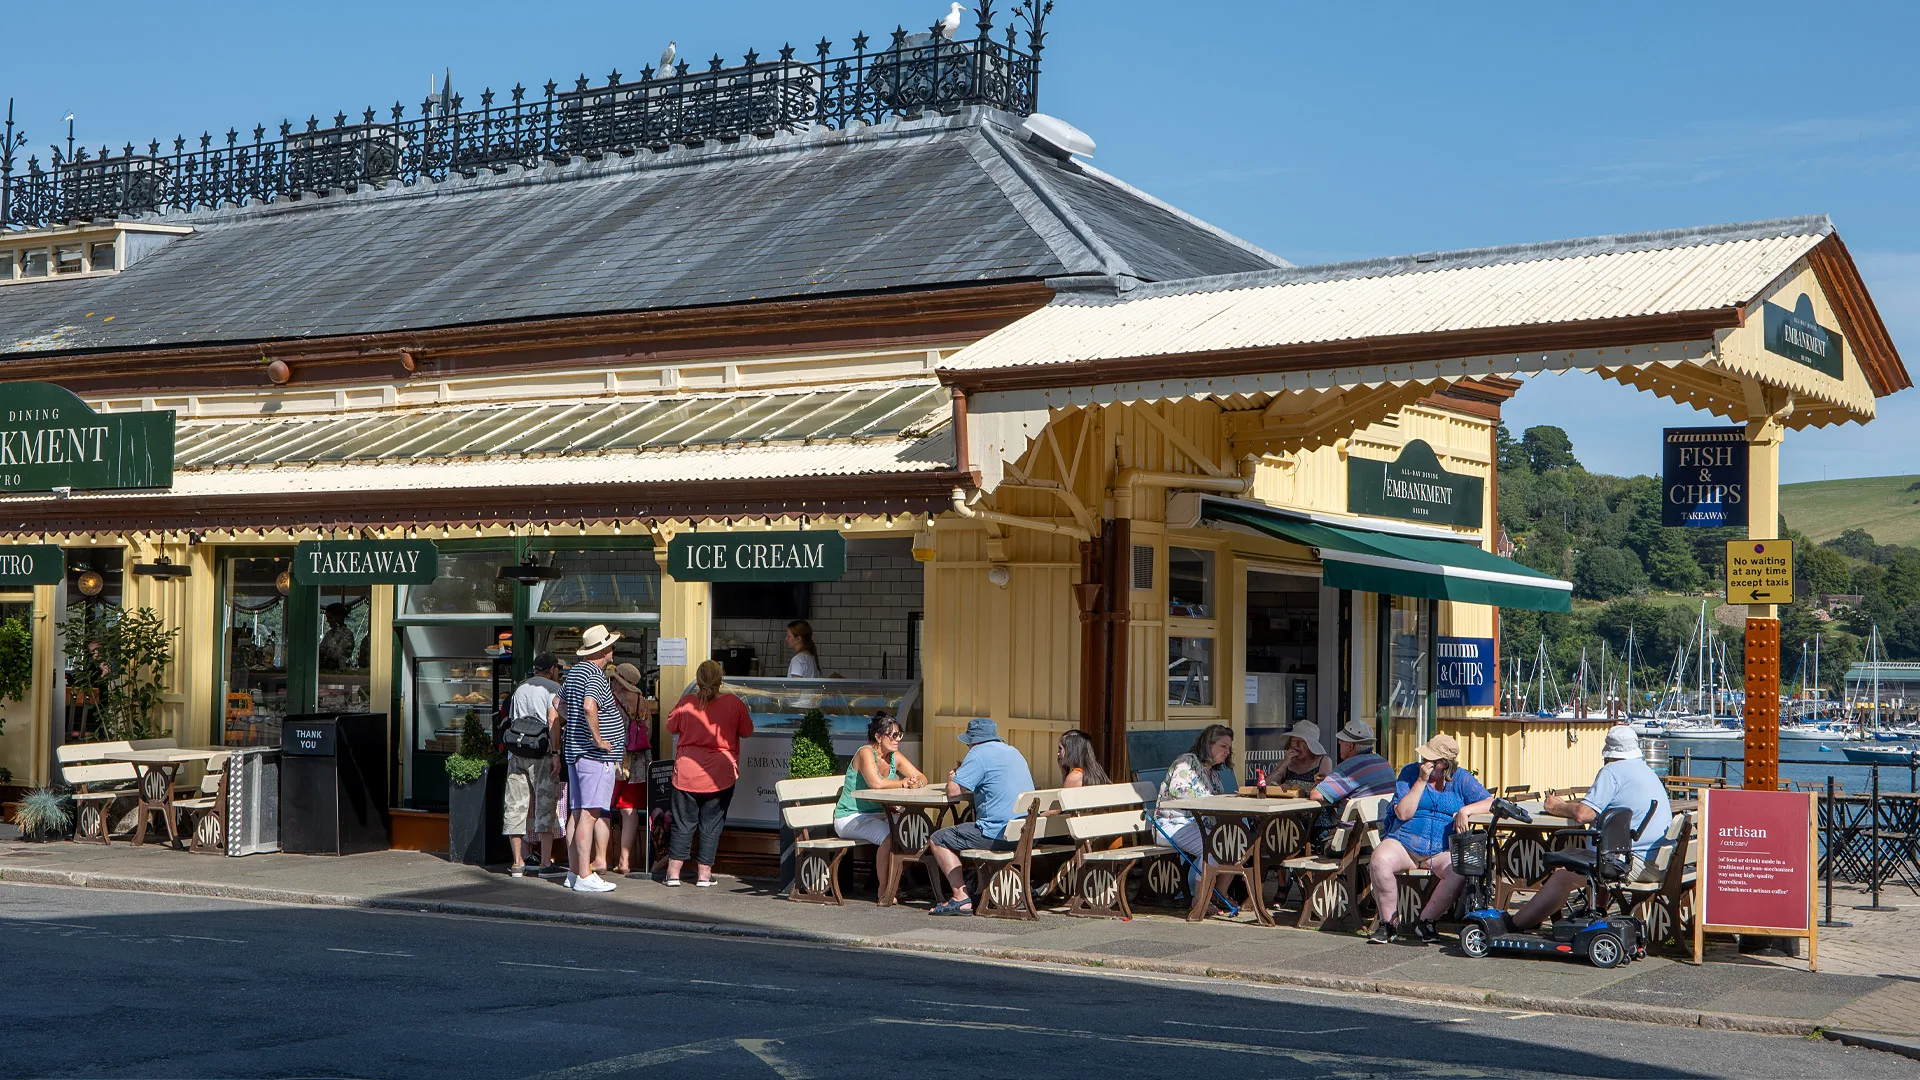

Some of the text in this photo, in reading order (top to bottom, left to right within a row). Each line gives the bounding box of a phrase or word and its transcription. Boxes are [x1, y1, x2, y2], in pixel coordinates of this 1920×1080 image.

[1784, 324, 1826, 357] EMBANKMENT
[9, 408, 59, 422] DINING
[0, 426, 109, 466] KMENT
[1678, 446, 1733, 467] FISH
[0, 474, 21, 486] RO
[1422, 471, 1439, 480] DINING
[1699, 468, 1712, 482] &
[1386, 478, 1453, 505] EMBANKMENT
[1669, 483, 1741, 505] CHIPS
[1412, 507, 1429, 516] BISTRO
[1681, 511, 1729, 520] TAKEAWAY
[0, 554, 34, 575] TRO
[309, 550, 421, 574] TAKEAWAY
[686, 544, 825, 569] ICE CREAM
[1733, 556, 1786, 567] No waiting
[1730, 578, 1790, 588] except taxis
[1732, 566, 1787, 577] at any time
[1440, 664, 1449, 682] &
[1449, 661, 1484, 686] CHIPS
[295, 729, 323, 739] THANK
[300, 740, 317, 749] YOU
[747, 756, 791, 769] EMBANK
[1245, 763, 1262, 780] ISH
[144, 771, 166, 802] GWR
[82, 806, 101, 835] GWR
[198, 815, 221, 845] GWR
[898, 813, 930, 850] GWR
[1718, 825, 1768, 839] artisan
[1212, 823, 1249, 863] GWR
[1266, 817, 1301, 854] GWR
[1507, 839, 1546, 879] GWR
[801, 856, 830, 894] GWR
[1057, 860, 1078, 896] GW
[1083, 869, 1118, 905] GWR
[1147, 859, 1182, 895] GWR
[1743, 872, 1775, 880] high-quality
[989, 869, 1023, 906] GWR
[1312, 878, 1349, 918] GWR
[1396, 884, 1422, 924] WR
[1630, 901, 1671, 941] WR
[1493, 940, 1529, 949] STYLE
